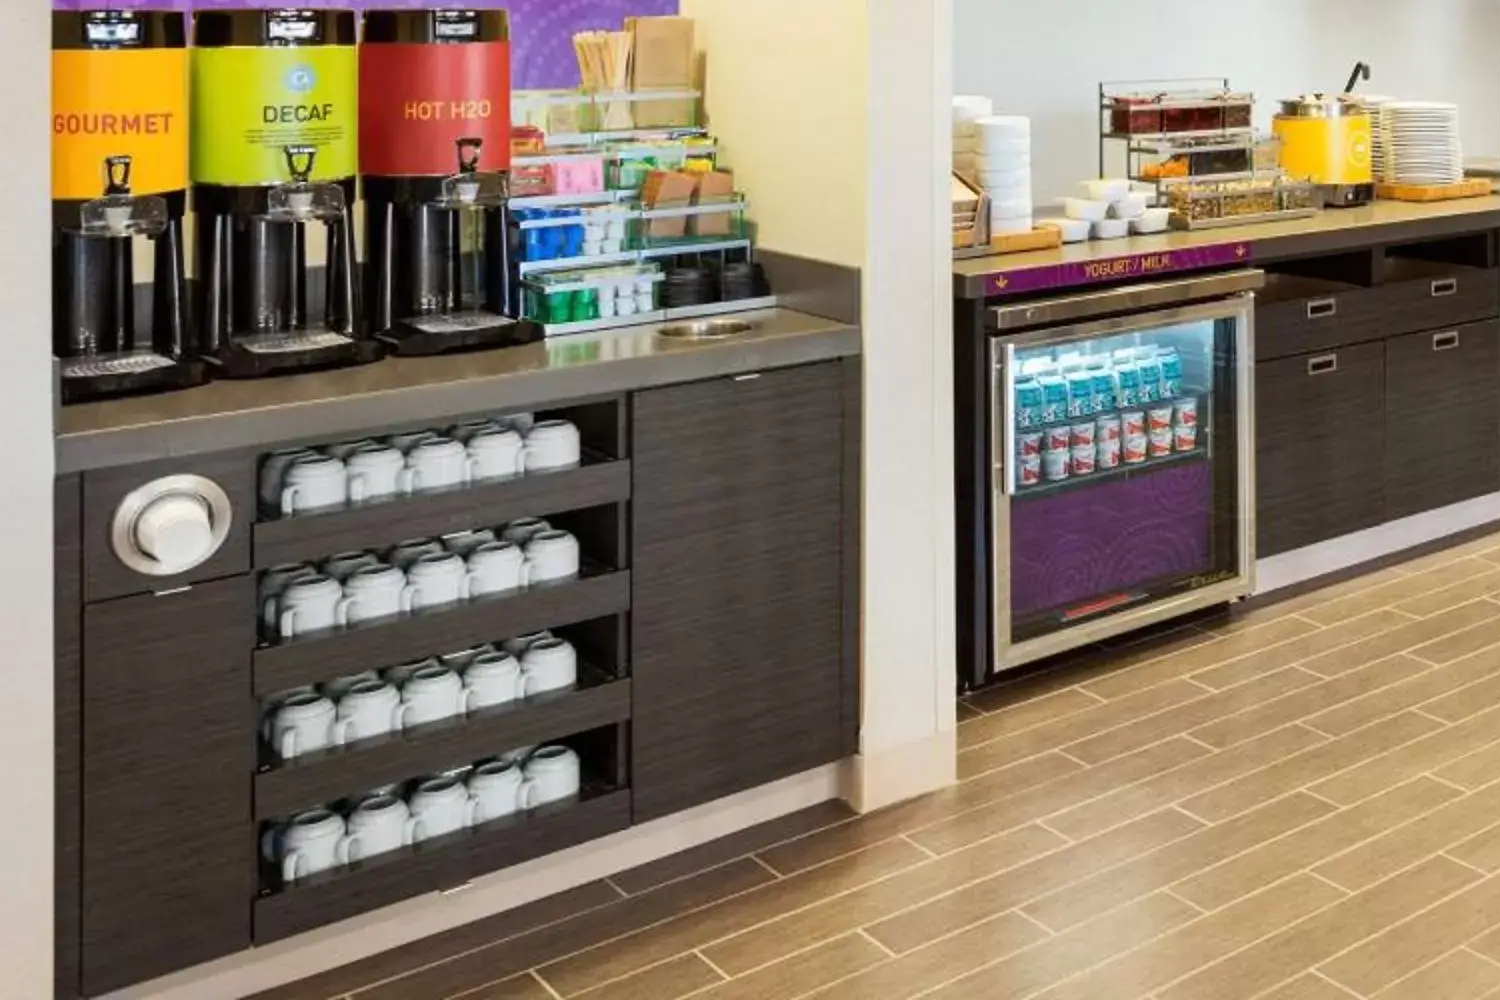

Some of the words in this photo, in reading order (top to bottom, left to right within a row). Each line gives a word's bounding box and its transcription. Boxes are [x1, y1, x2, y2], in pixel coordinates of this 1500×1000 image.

[262, 103, 334, 123] DECAF
[404, 101, 442, 121] HOT
[451, 99, 492, 119] H2O
[53, 113, 174, 136] GOURMET
[1085, 259, 1131, 278] YOGURT
[1141, 253, 1170, 273] MILK
